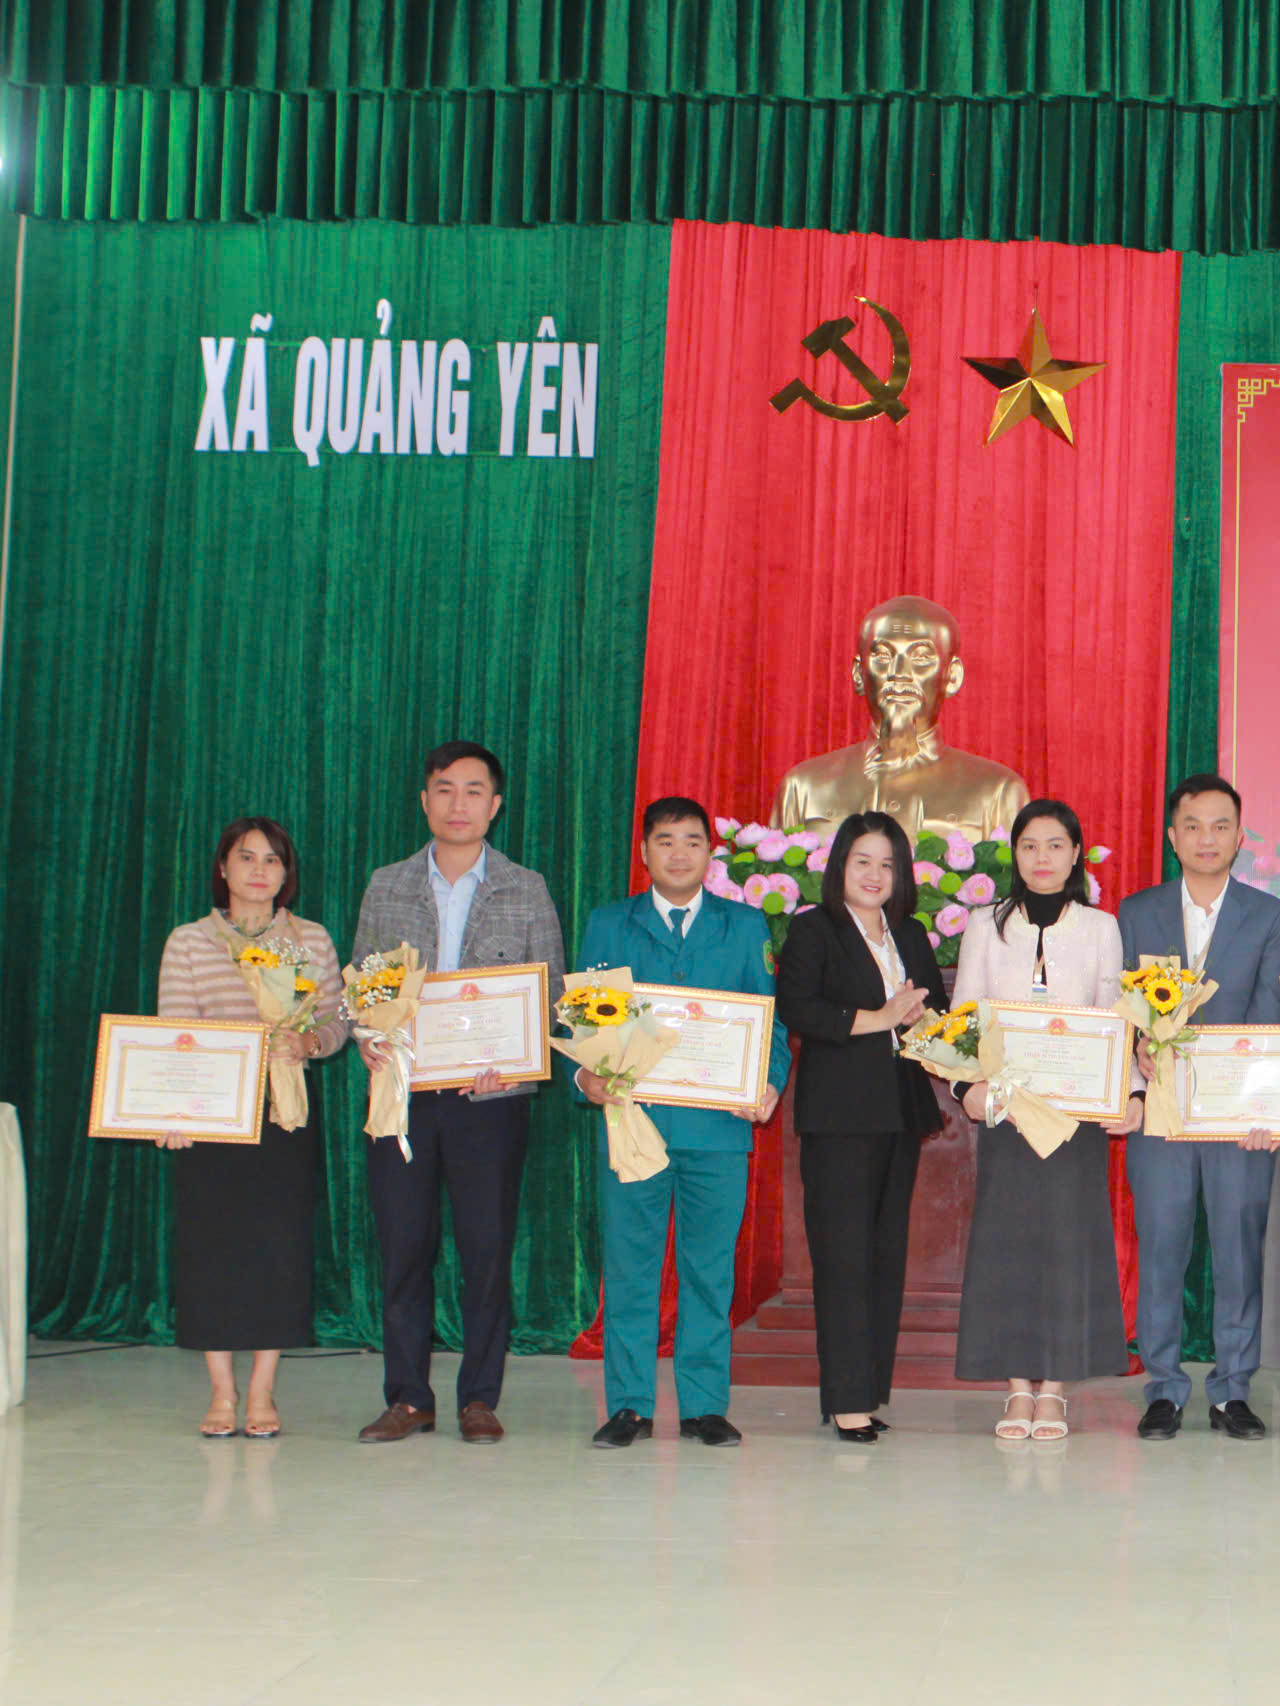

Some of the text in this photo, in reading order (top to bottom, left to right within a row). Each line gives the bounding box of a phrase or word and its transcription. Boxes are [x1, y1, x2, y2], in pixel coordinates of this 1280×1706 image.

[194, 298, 599, 467] XÃ QUẢNG YÊN
